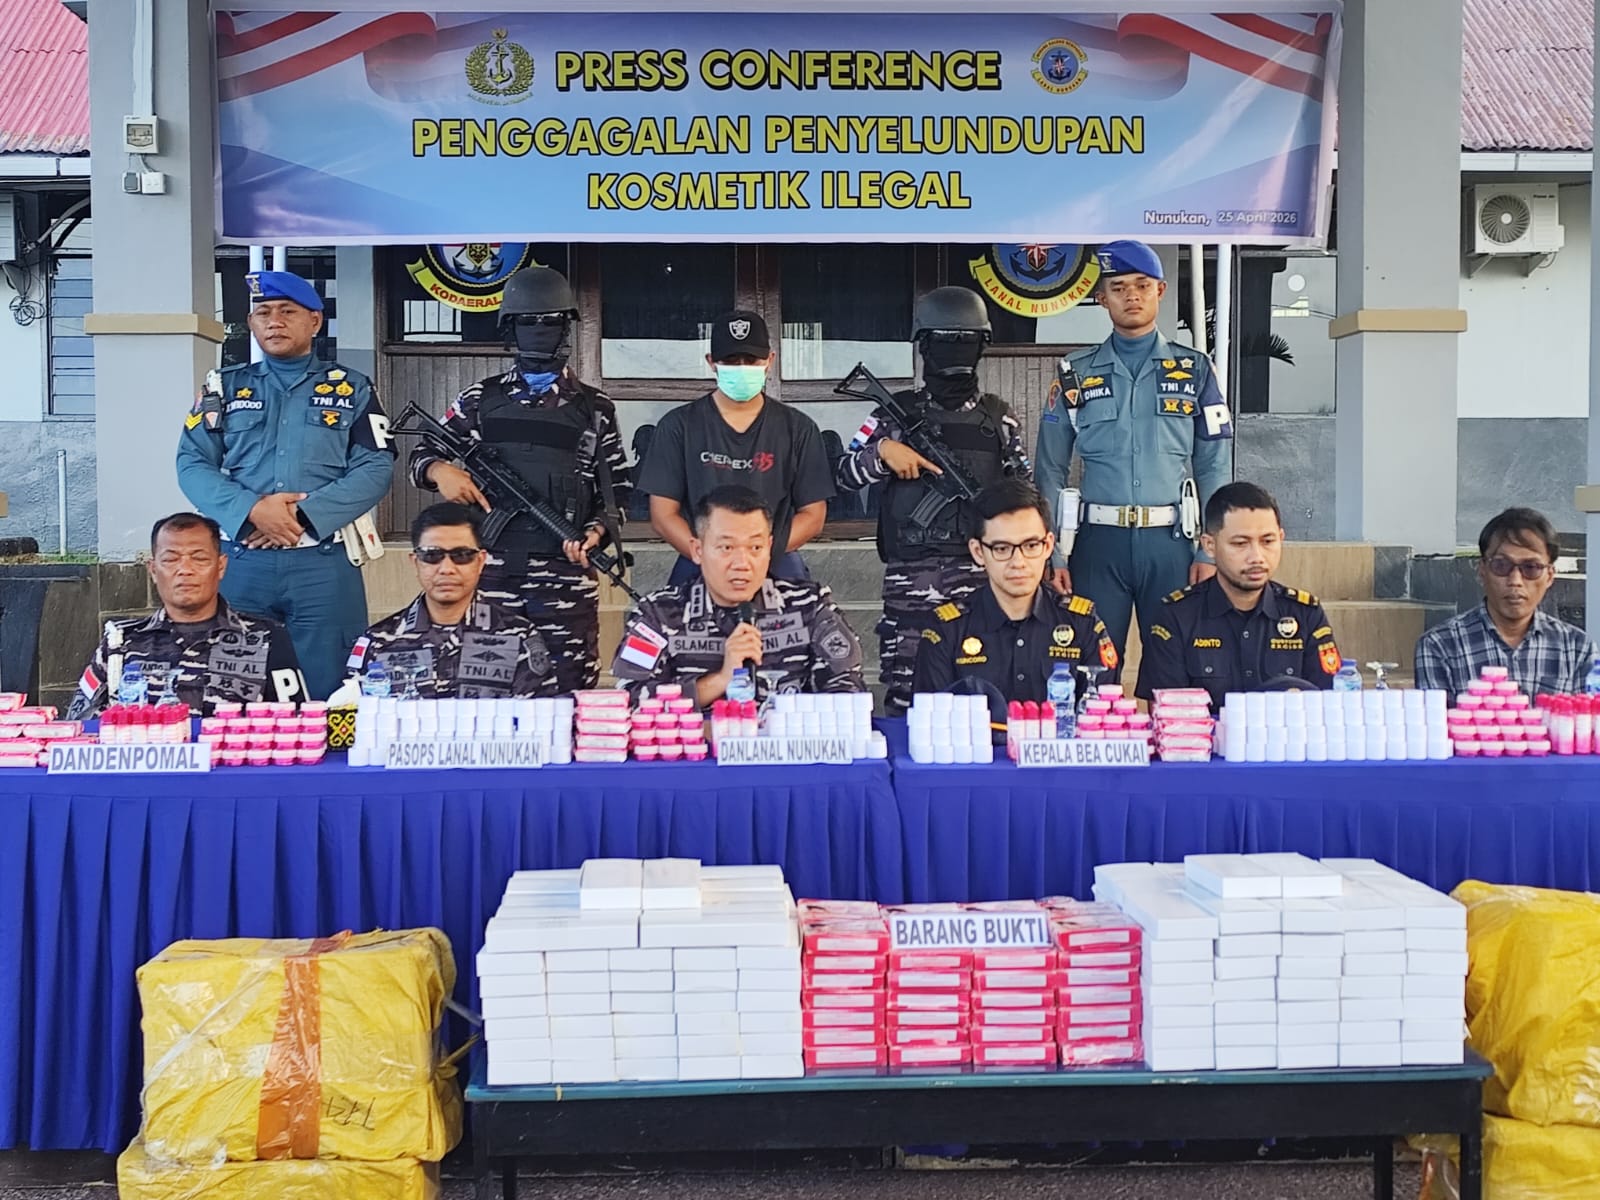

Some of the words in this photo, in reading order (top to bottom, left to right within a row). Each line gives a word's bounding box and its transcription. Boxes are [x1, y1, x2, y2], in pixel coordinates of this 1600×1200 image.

[555, 50, 689, 94] PRESS
[700, 50, 1002, 94] CONFERENCE
[412, 116, 751, 158] PENGGAGALAN
[765, 115, 1145, 155] PENYELUNDUPAN
[587, 171, 810, 210] KOSMETIK
[821, 171, 972, 209] ILEGAL
[1144, 210, 1211, 226] Nunukan,
[1218, 211, 1233, 222] 25
[1237, 211, 1267, 223] April
[1271, 211, 1297, 223] 2026
[430, 283, 502, 308] KODAERAL
[984, 278, 1022, 311] LANAL
[1031, 277, 1092, 313] NUNUKAN
[1160, 382, 1179, 393] TNI
[1183, 383, 1196, 394] AL
[312, 396, 333, 406] TNI
[336, 398, 354, 409] AL
[674, 639, 722, 651] SLAMET
[760, 636, 779, 650] NI
[786, 632, 803, 645] AL
[216, 661, 237, 671] TNI
[242, 664, 260, 674] AL
[464, 665, 487, 676] TNI
[493, 668, 511, 680] AL
[52, 747, 199, 770] DANDENPOMAL
[389, 743, 435, 765] PASOPS
[438, 743, 476, 765] LANAL
[480, 742, 540, 765] NUNUKAN
[721, 741, 783, 762] DANLANAL
[1023, 743, 1072, 763] KEPALA
[1076, 743, 1102, 763] BEA
[1105, 743, 1145, 763] CUKAI
[896, 919, 977, 945] BARANG
[984, 918, 1044, 943] BUKTI
